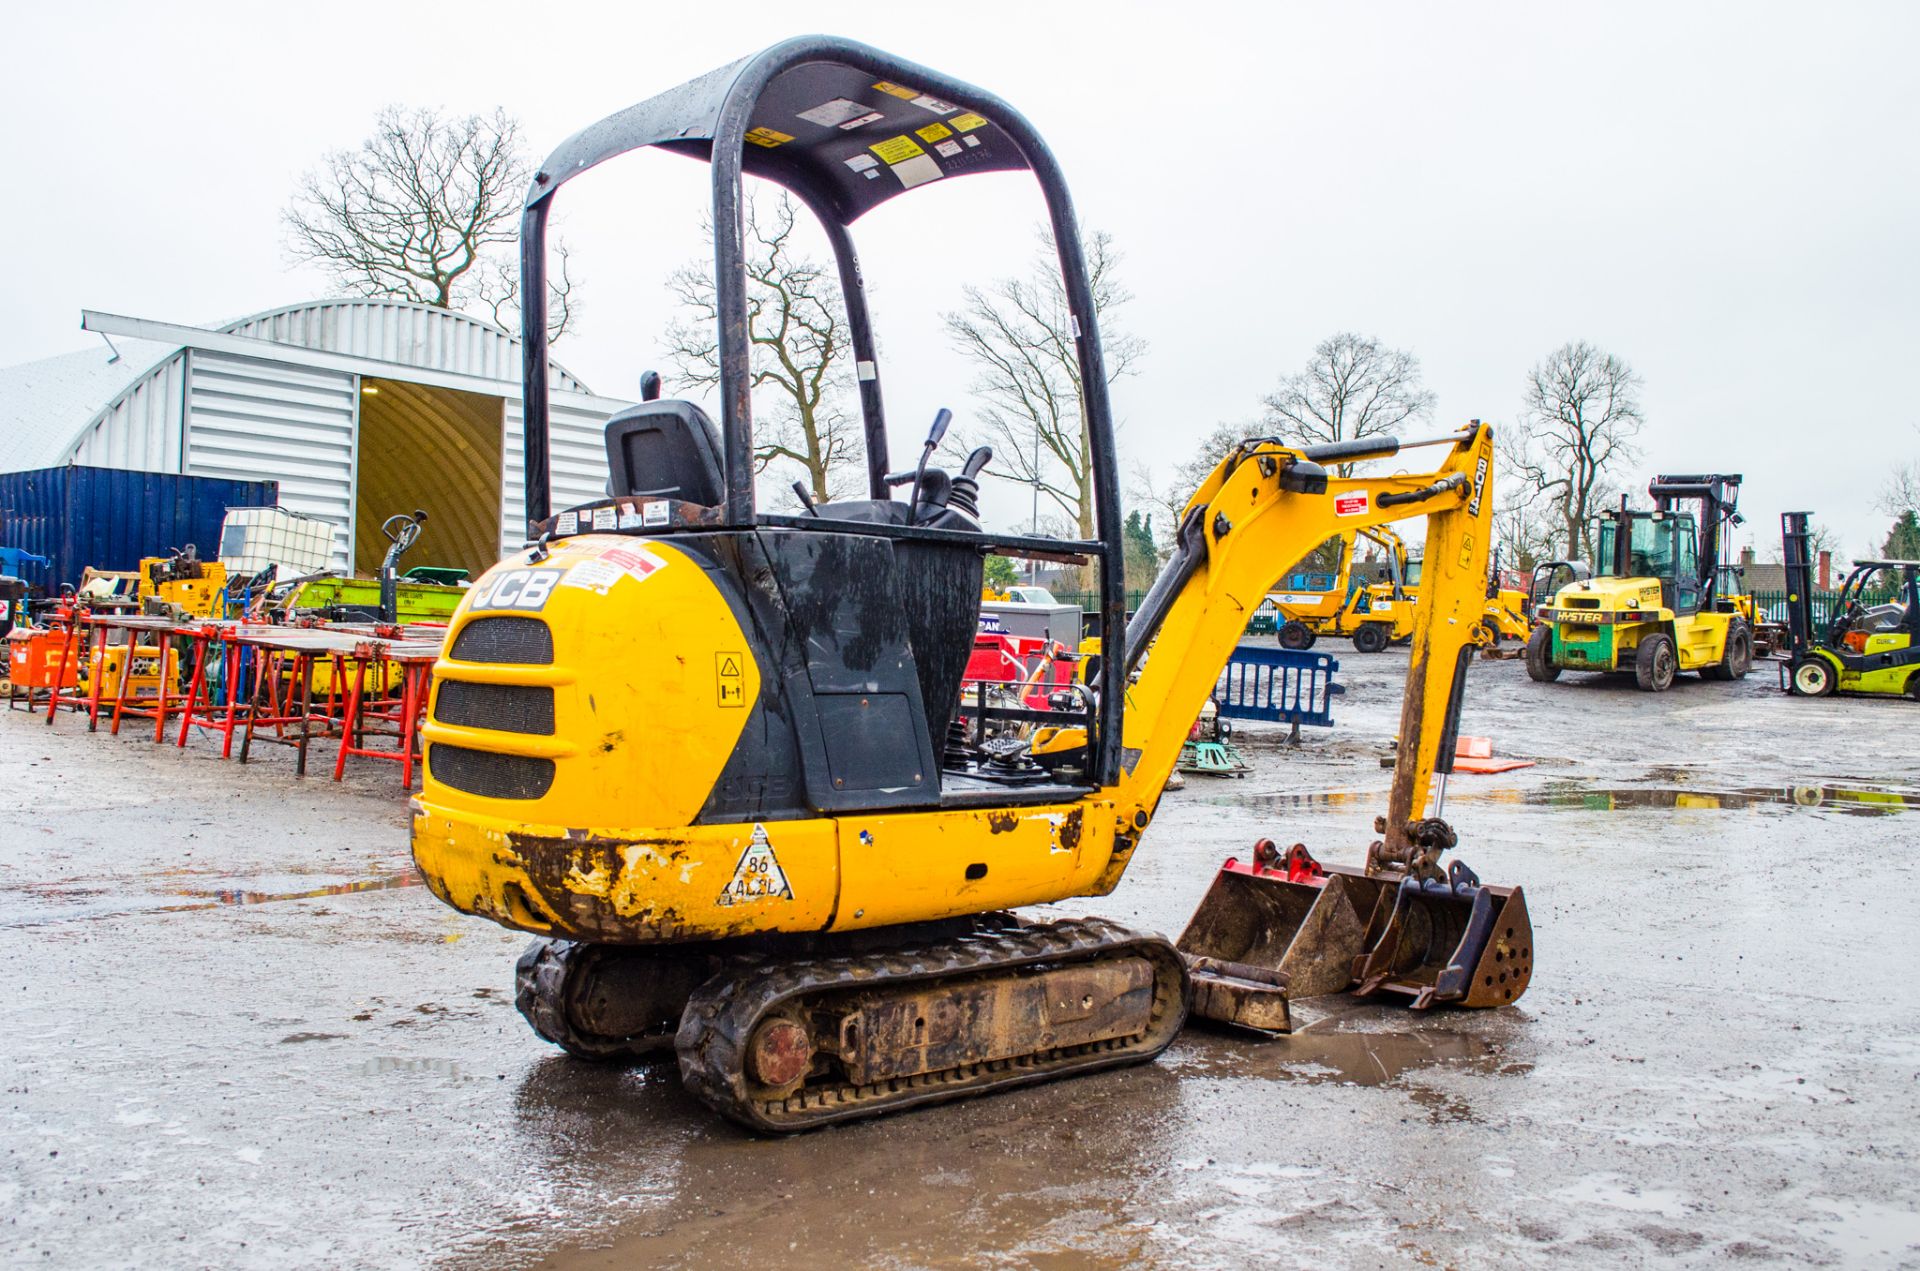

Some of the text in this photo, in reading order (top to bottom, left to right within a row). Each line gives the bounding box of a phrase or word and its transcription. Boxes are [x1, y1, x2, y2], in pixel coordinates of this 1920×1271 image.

[1470, 457, 1488, 509] 8014
[472, 571, 560, 608] JCB
[1639, 586, 1660, 596] HYSTER
[1557, 611, 1602, 622] HYSTER
[749, 856, 768, 873] 86
